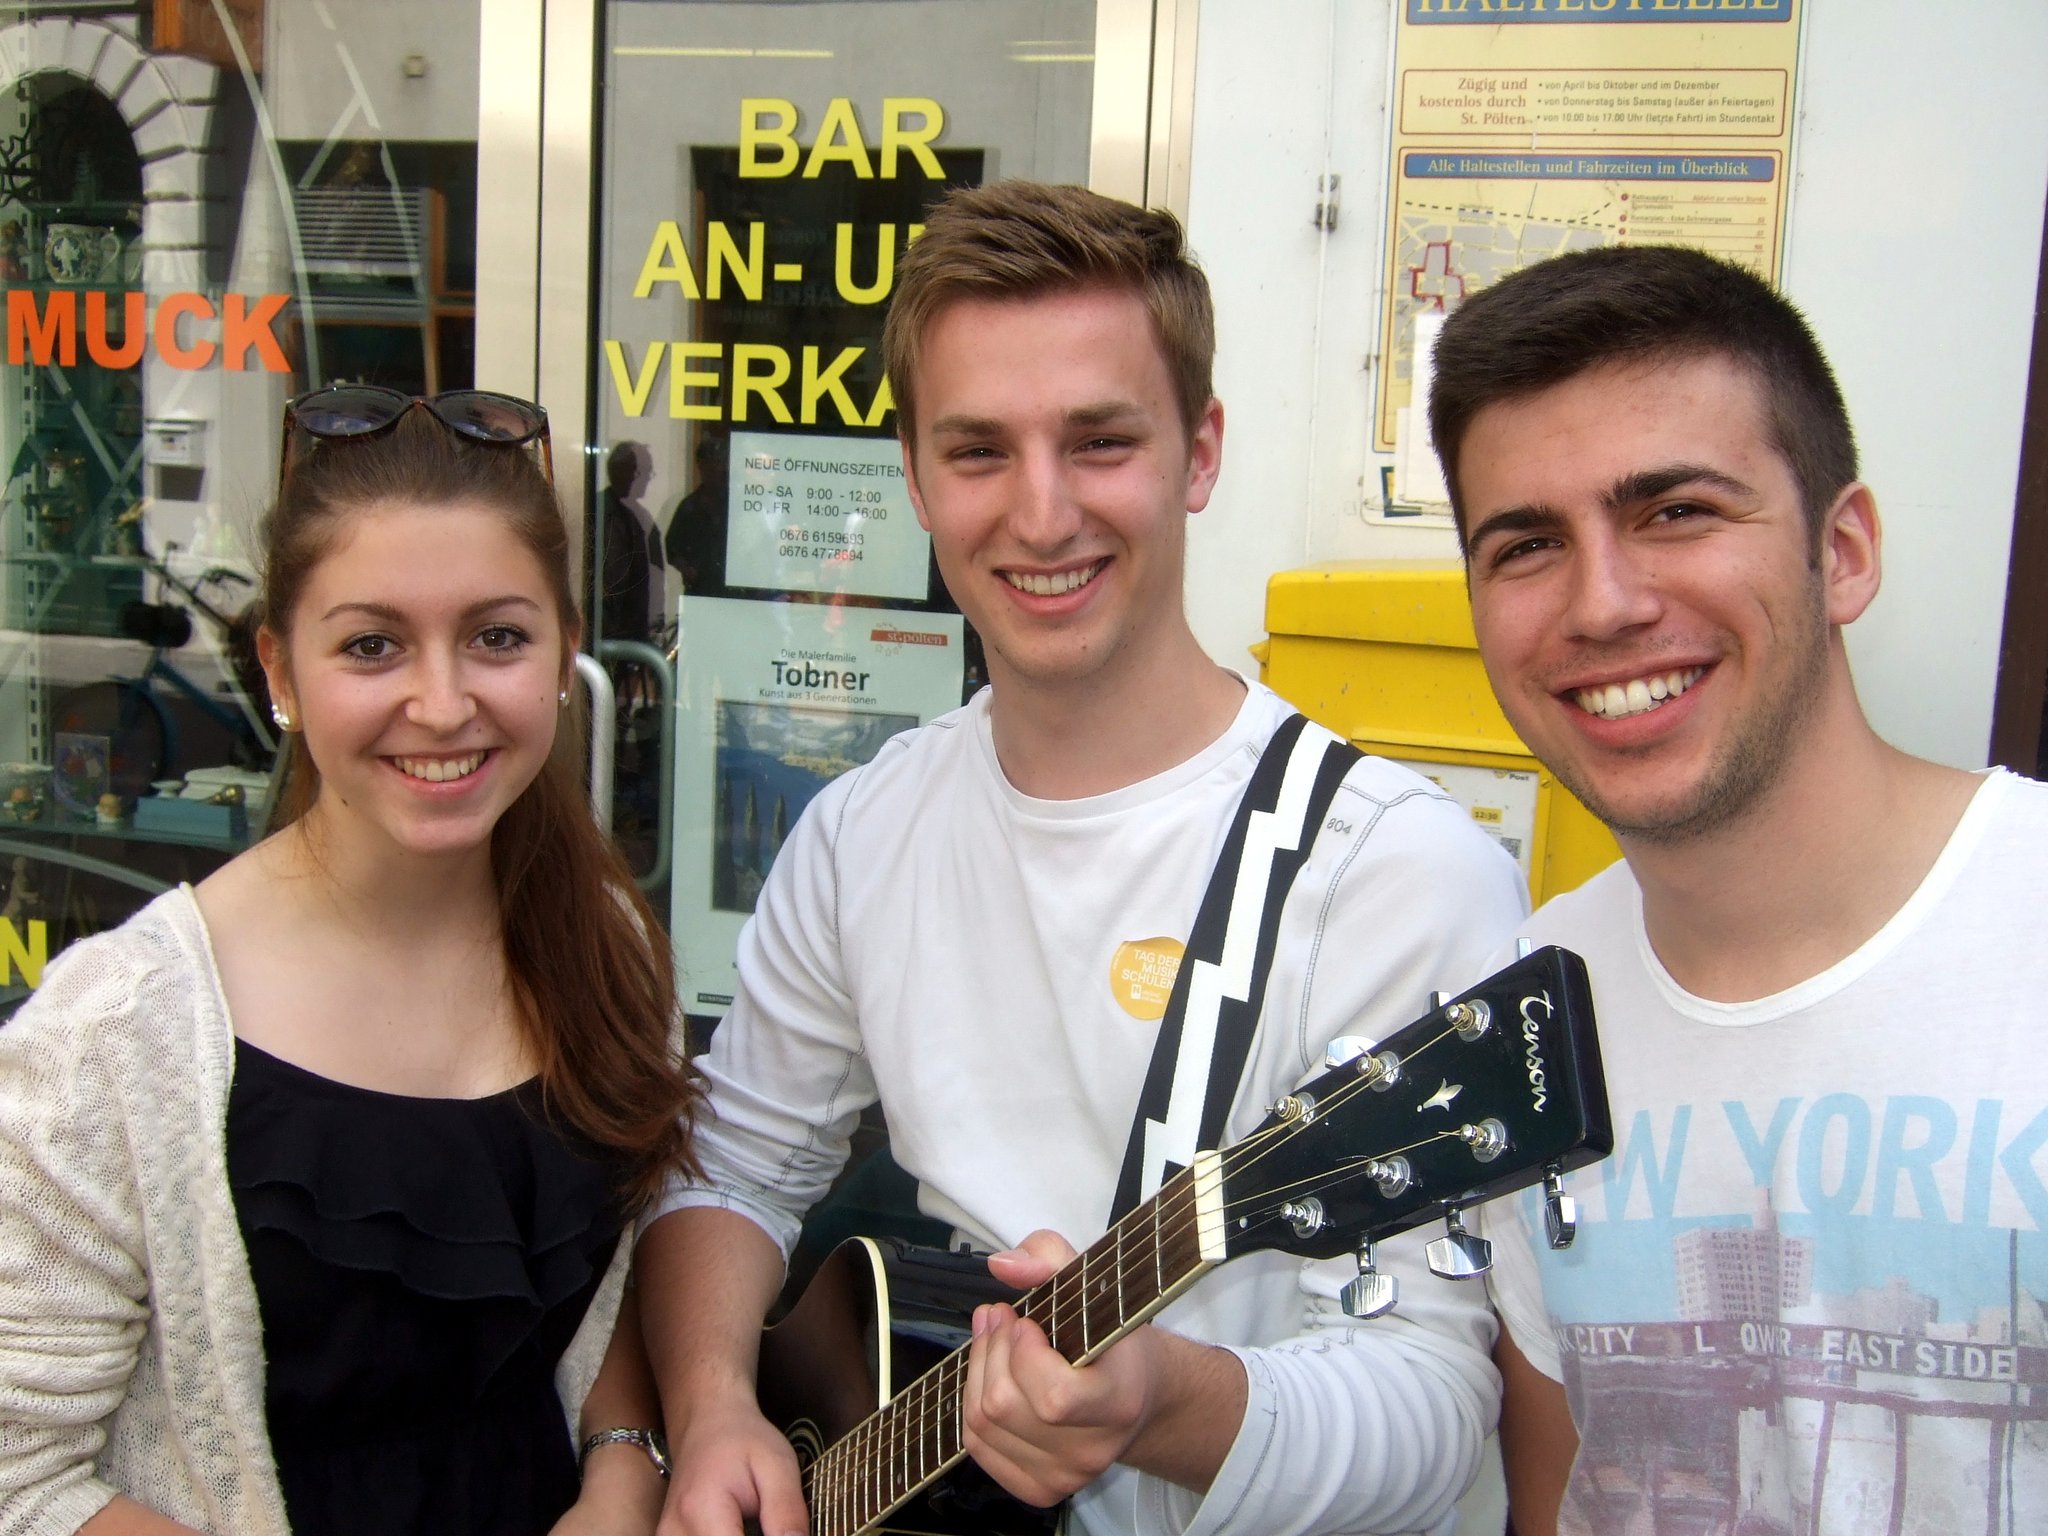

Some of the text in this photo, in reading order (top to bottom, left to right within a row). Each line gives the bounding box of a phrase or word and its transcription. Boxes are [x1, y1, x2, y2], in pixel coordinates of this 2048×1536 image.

[1457, 77, 1528, 92] Zügig und
[1545, 80, 1720, 92] von April bis Oktober und im Dezember
[1419, 95, 1527, 108] kostenlos durch
[1544, 98, 1561, 107] von
[1562, 97, 1614, 108] Donnerstag
[1617, 97, 1630, 107] bis
[1633, 97, 1672, 108] Samstag
[1721, 96, 1775, 108] Feiertagen)
[1460, 112, 1526, 125] St. Pölten
[1543, 114, 1559, 122] von
[1586, 113, 1599, 122] bis
[1627, 113, 1643, 123] Uhr
[1705, 114, 1716, 123] im
[1719, 113, 1775, 124] Stundentakt
[738, 97, 947, 180] BAR
[1427, 158, 1749, 176] Alle Haltestellen und Fahrzeiten im Überblick
[633, 220, 927, 305] AN- U
[7, 288, 292, 373] MUCK
[744, 457, 905, 478] NEUE ÖFFNUNGSZEITEN
[744, 484, 765, 496] MO
[776, 485, 793, 498] SA
[806, 487, 833, 500] 9:00
[849, 489, 882, 503] 12:00
[743, 500, 763, 512] DO
[773, 501, 790, 514] FR
[806, 505, 840, 517] 14:00
[855, 507, 887, 520] 16:00
[780, 528, 809, 542] 0676
[779, 545, 809, 558] 0676
[781, 648, 857, 664] Die Malerfamilie
[771, 659, 870, 691] Tobner
[759, 687, 877, 705] Kunst aus 3 Generationen
[1134, 948, 1155, 963] TAG
[1721, 1091, 2048, 1232] YORK
[1575, 1326, 1636, 1355] CITY
[1821, 1329, 1905, 1369] EAST
[1914, 1341, 2018, 1381] SIDE
